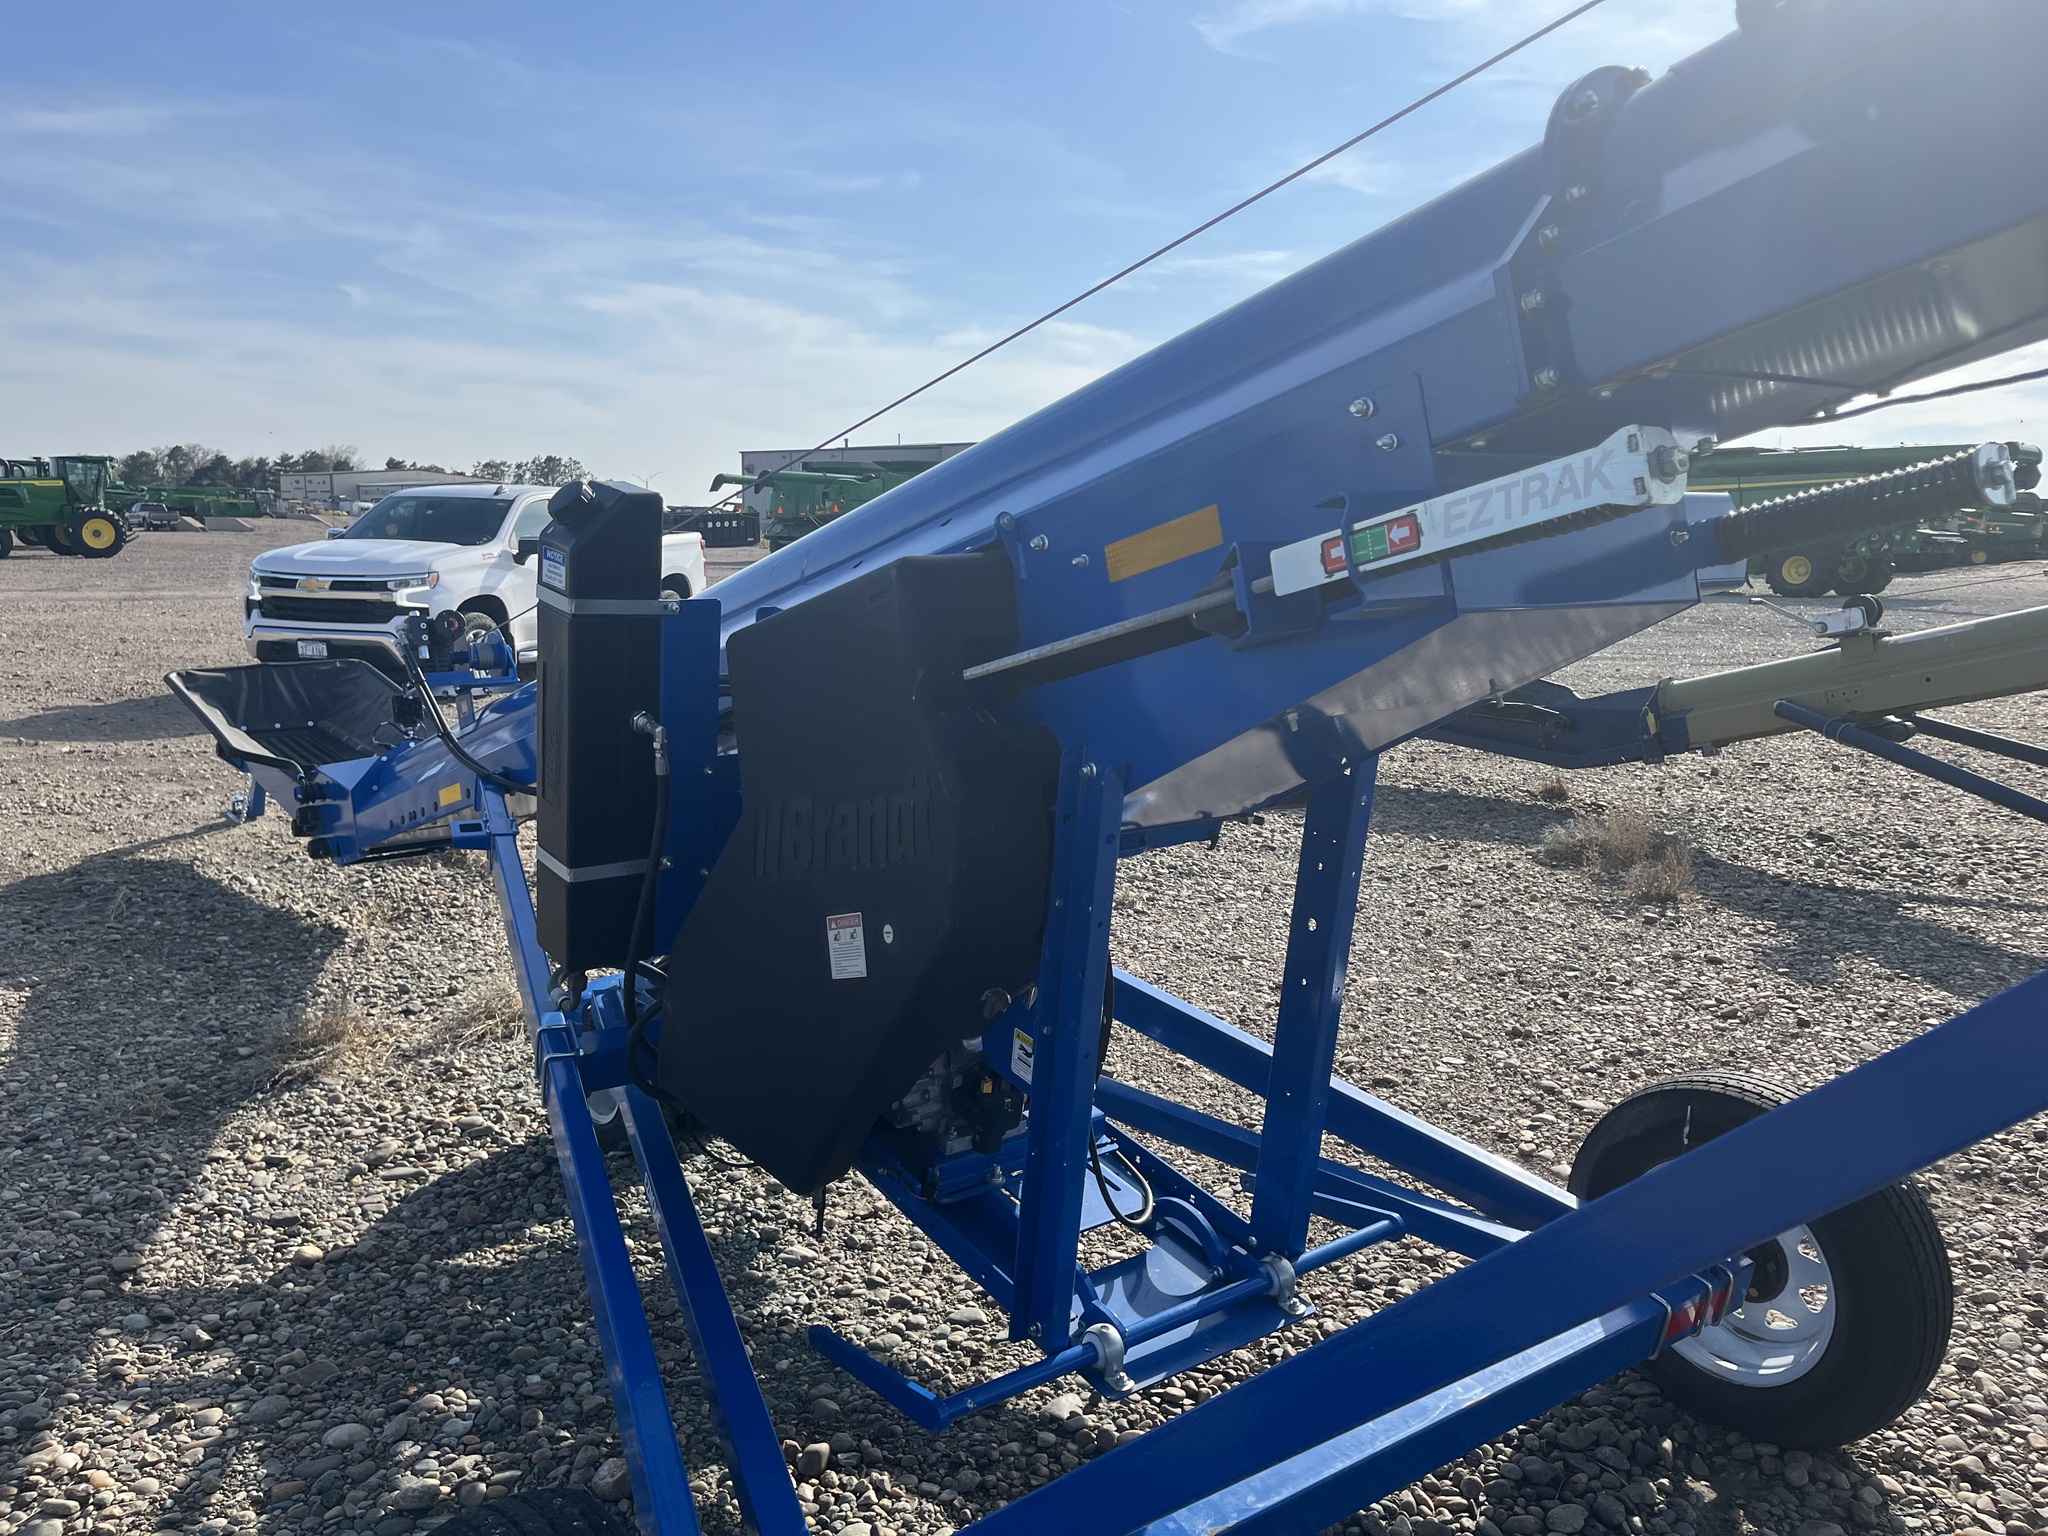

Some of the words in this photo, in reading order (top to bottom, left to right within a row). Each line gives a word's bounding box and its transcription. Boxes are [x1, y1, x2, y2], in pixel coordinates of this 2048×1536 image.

[1443, 450, 1615, 539] EZTRAK
[546, 549, 564, 563] NOTICE
[776, 772, 934, 874] Brandt
[836, 917, 859, 927] DANGER
